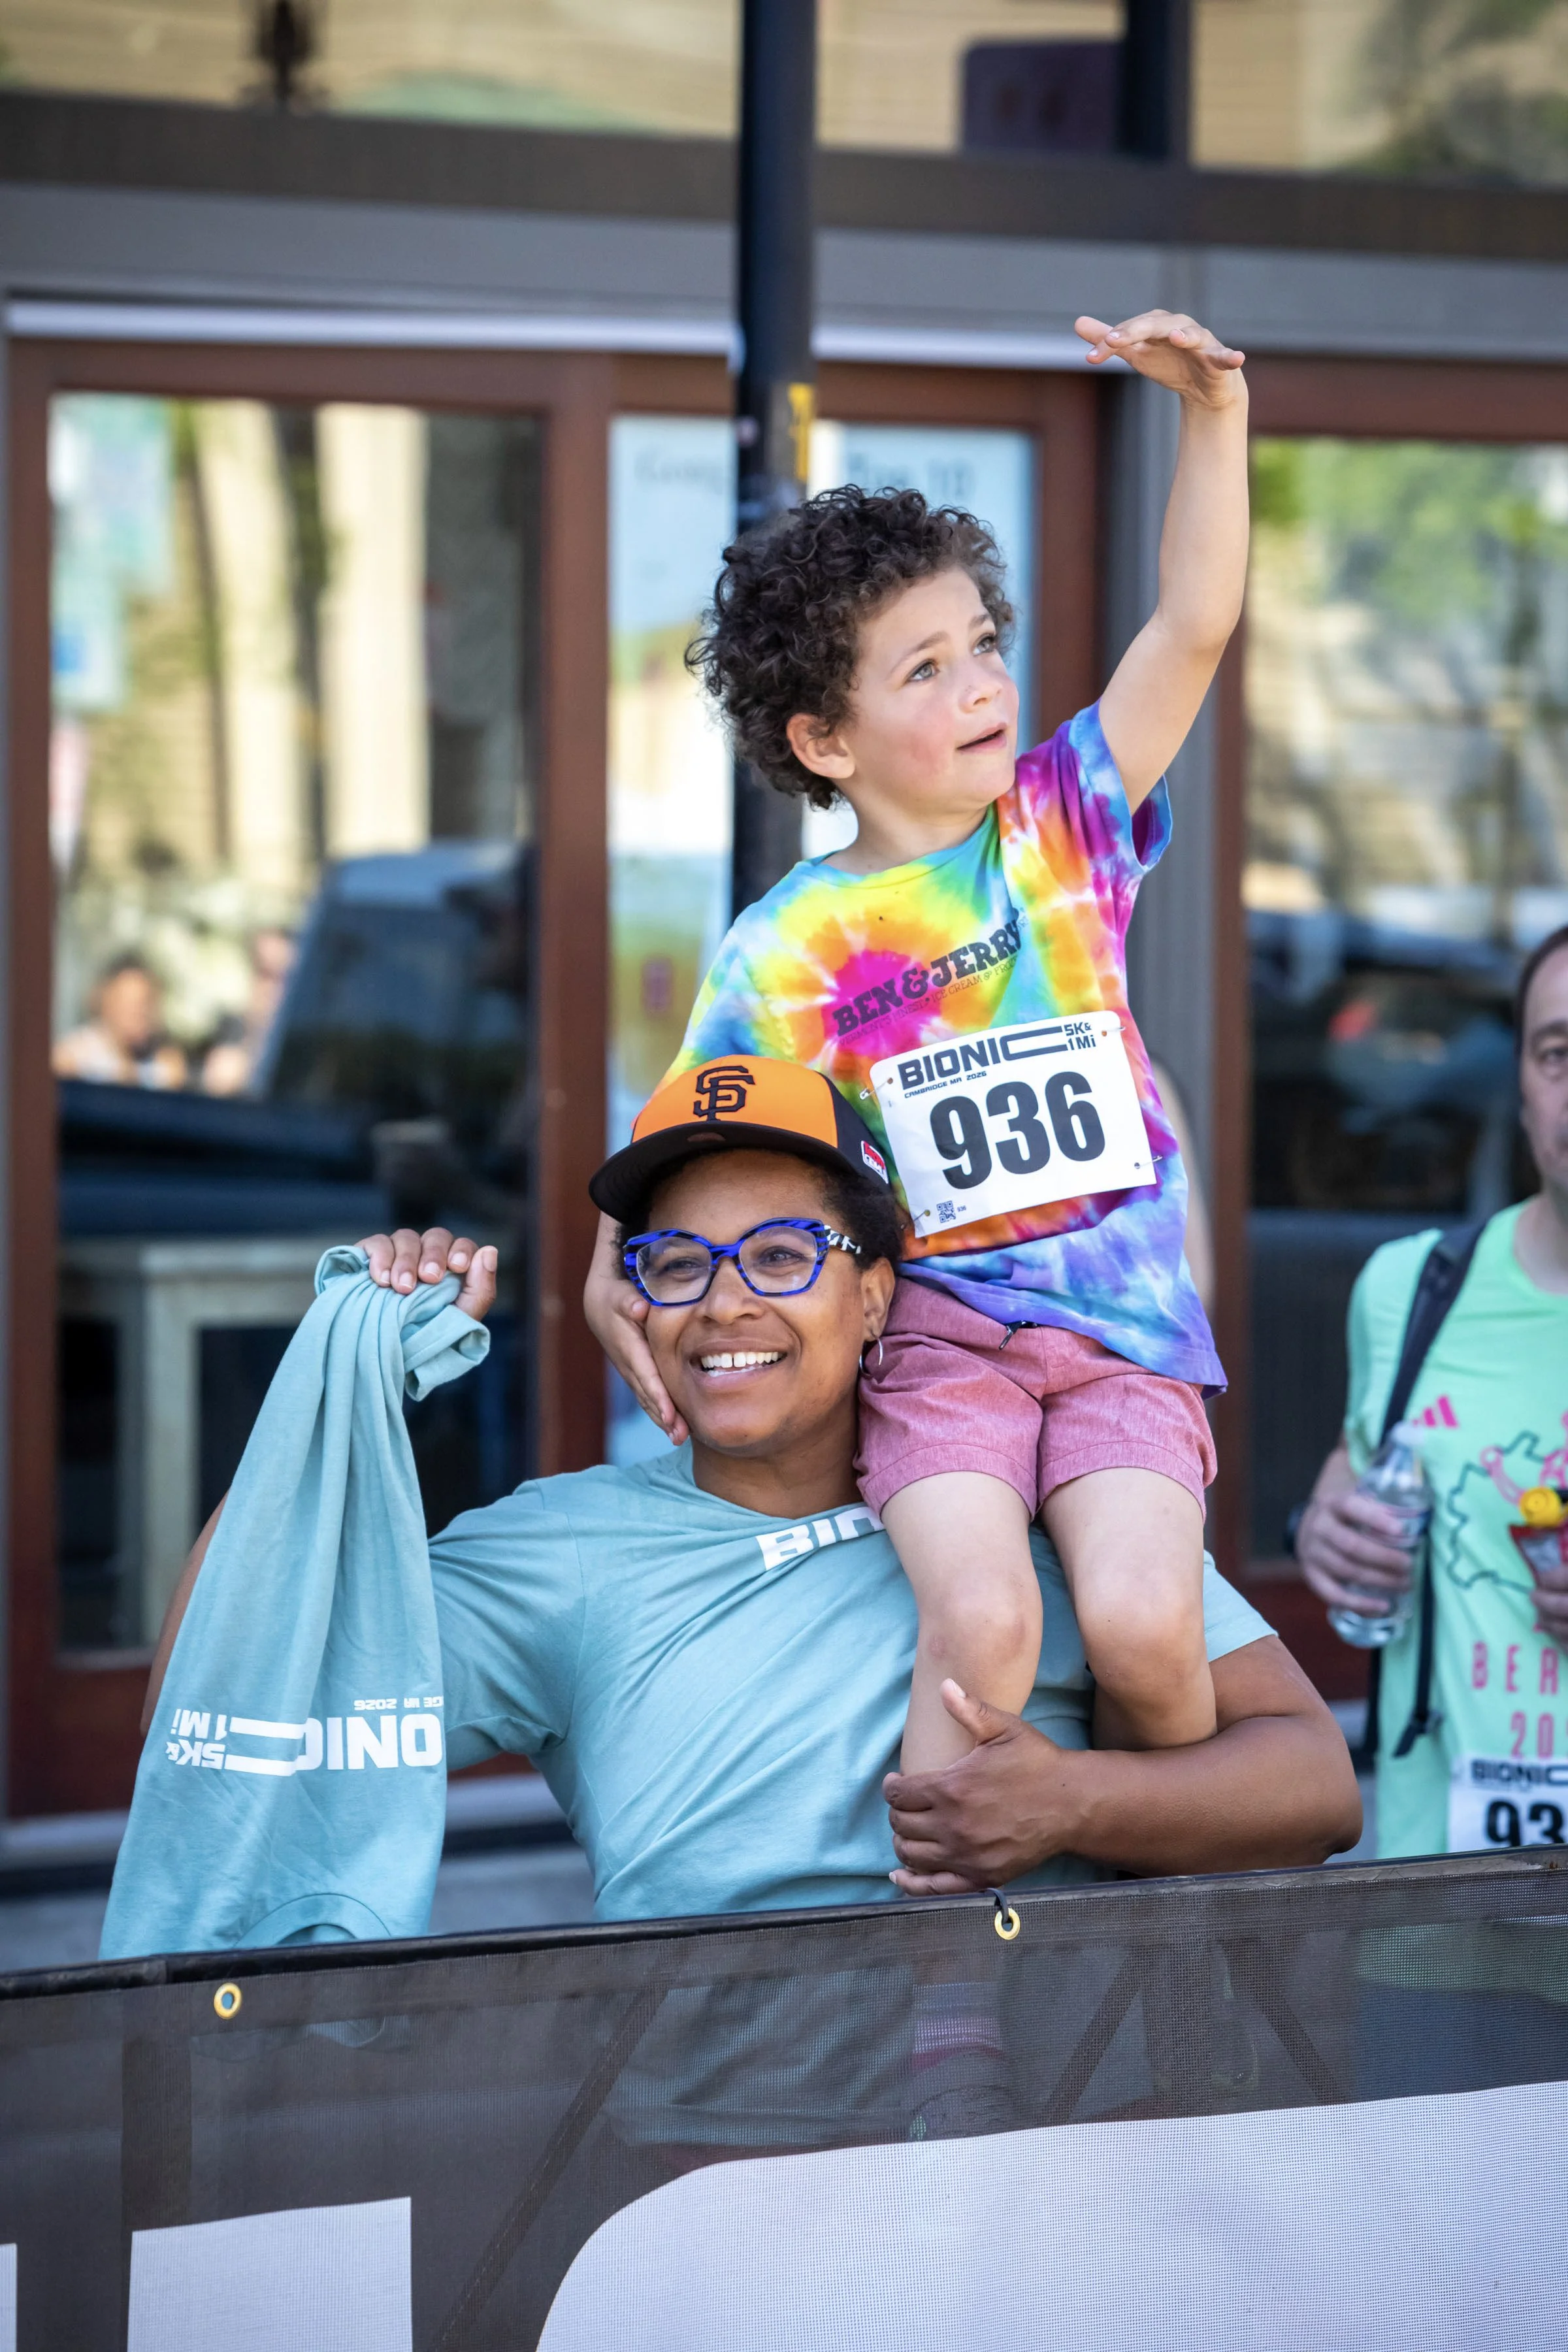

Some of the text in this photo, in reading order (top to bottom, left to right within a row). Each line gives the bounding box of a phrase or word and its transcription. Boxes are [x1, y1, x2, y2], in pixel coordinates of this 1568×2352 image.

[931, 990, 947, 1004] ICE
[948, 975, 983, 995] CREAM
[897, 1026, 1069, 1090] BIONIC
[904, 1081, 947, 1098] CAMBRIDGE
[966, 1071, 987, 1081] 2026
[930, 1071, 1105, 1190] 936
[755, 1507, 886, 1571] BIO
[1472, 1641, 1559, 1695] BEA
[225, 1713, 443, 1776] ONIC
[1510, 1710, 1568, 1760] 20
[1485, 1799, 1568, 1848] 93
